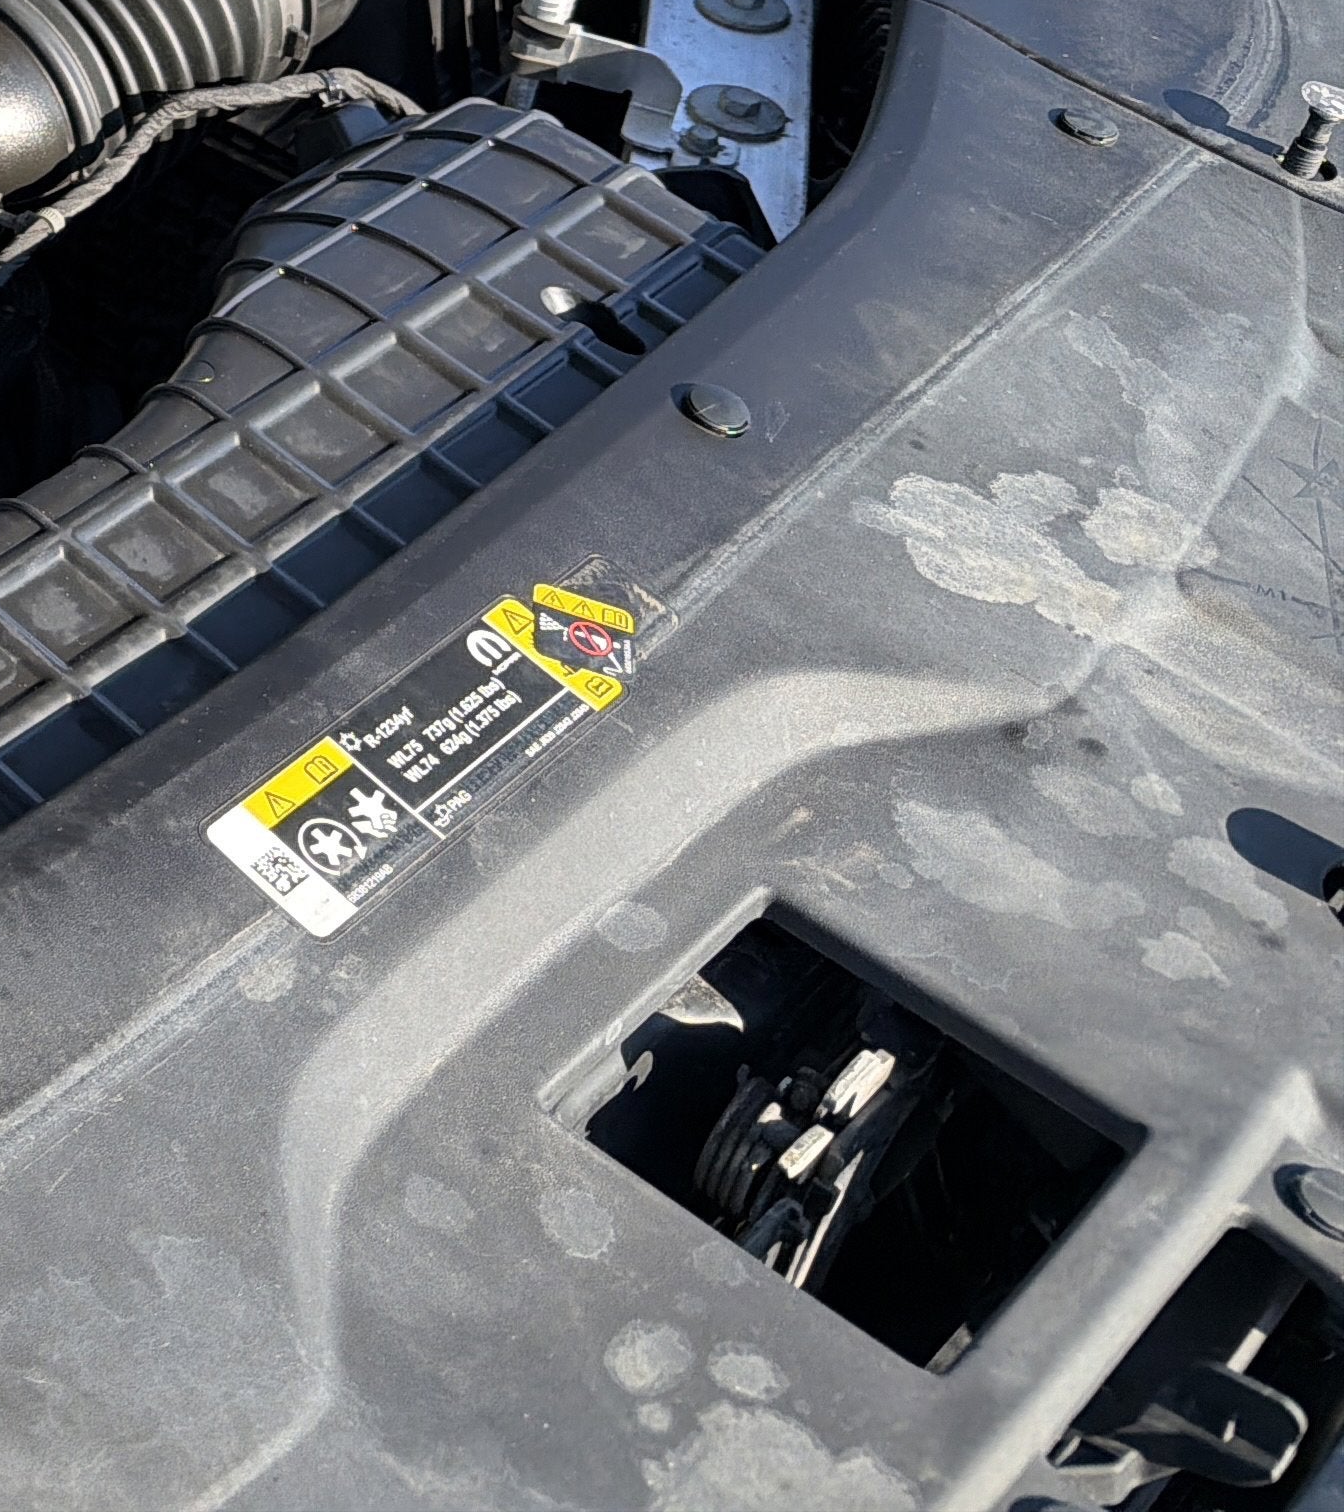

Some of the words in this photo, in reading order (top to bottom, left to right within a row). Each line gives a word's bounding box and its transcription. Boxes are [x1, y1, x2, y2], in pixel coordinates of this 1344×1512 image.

[363, 705, 414, 749] R-1234yf
[386, 739, 424, 768] WL75
[422, 717, 457, 741] 737g
[448, 691, 484, 723] (1.625
[477, 676, 506, 698] lbs)
[403, 753, 440, 782] WL74
[439, 731, 473, 755] 624g
[464, 705, 501, 737] (1.375
[493, 690, 523, 711] lbs)
[447, 789, 472, 811] PAG
